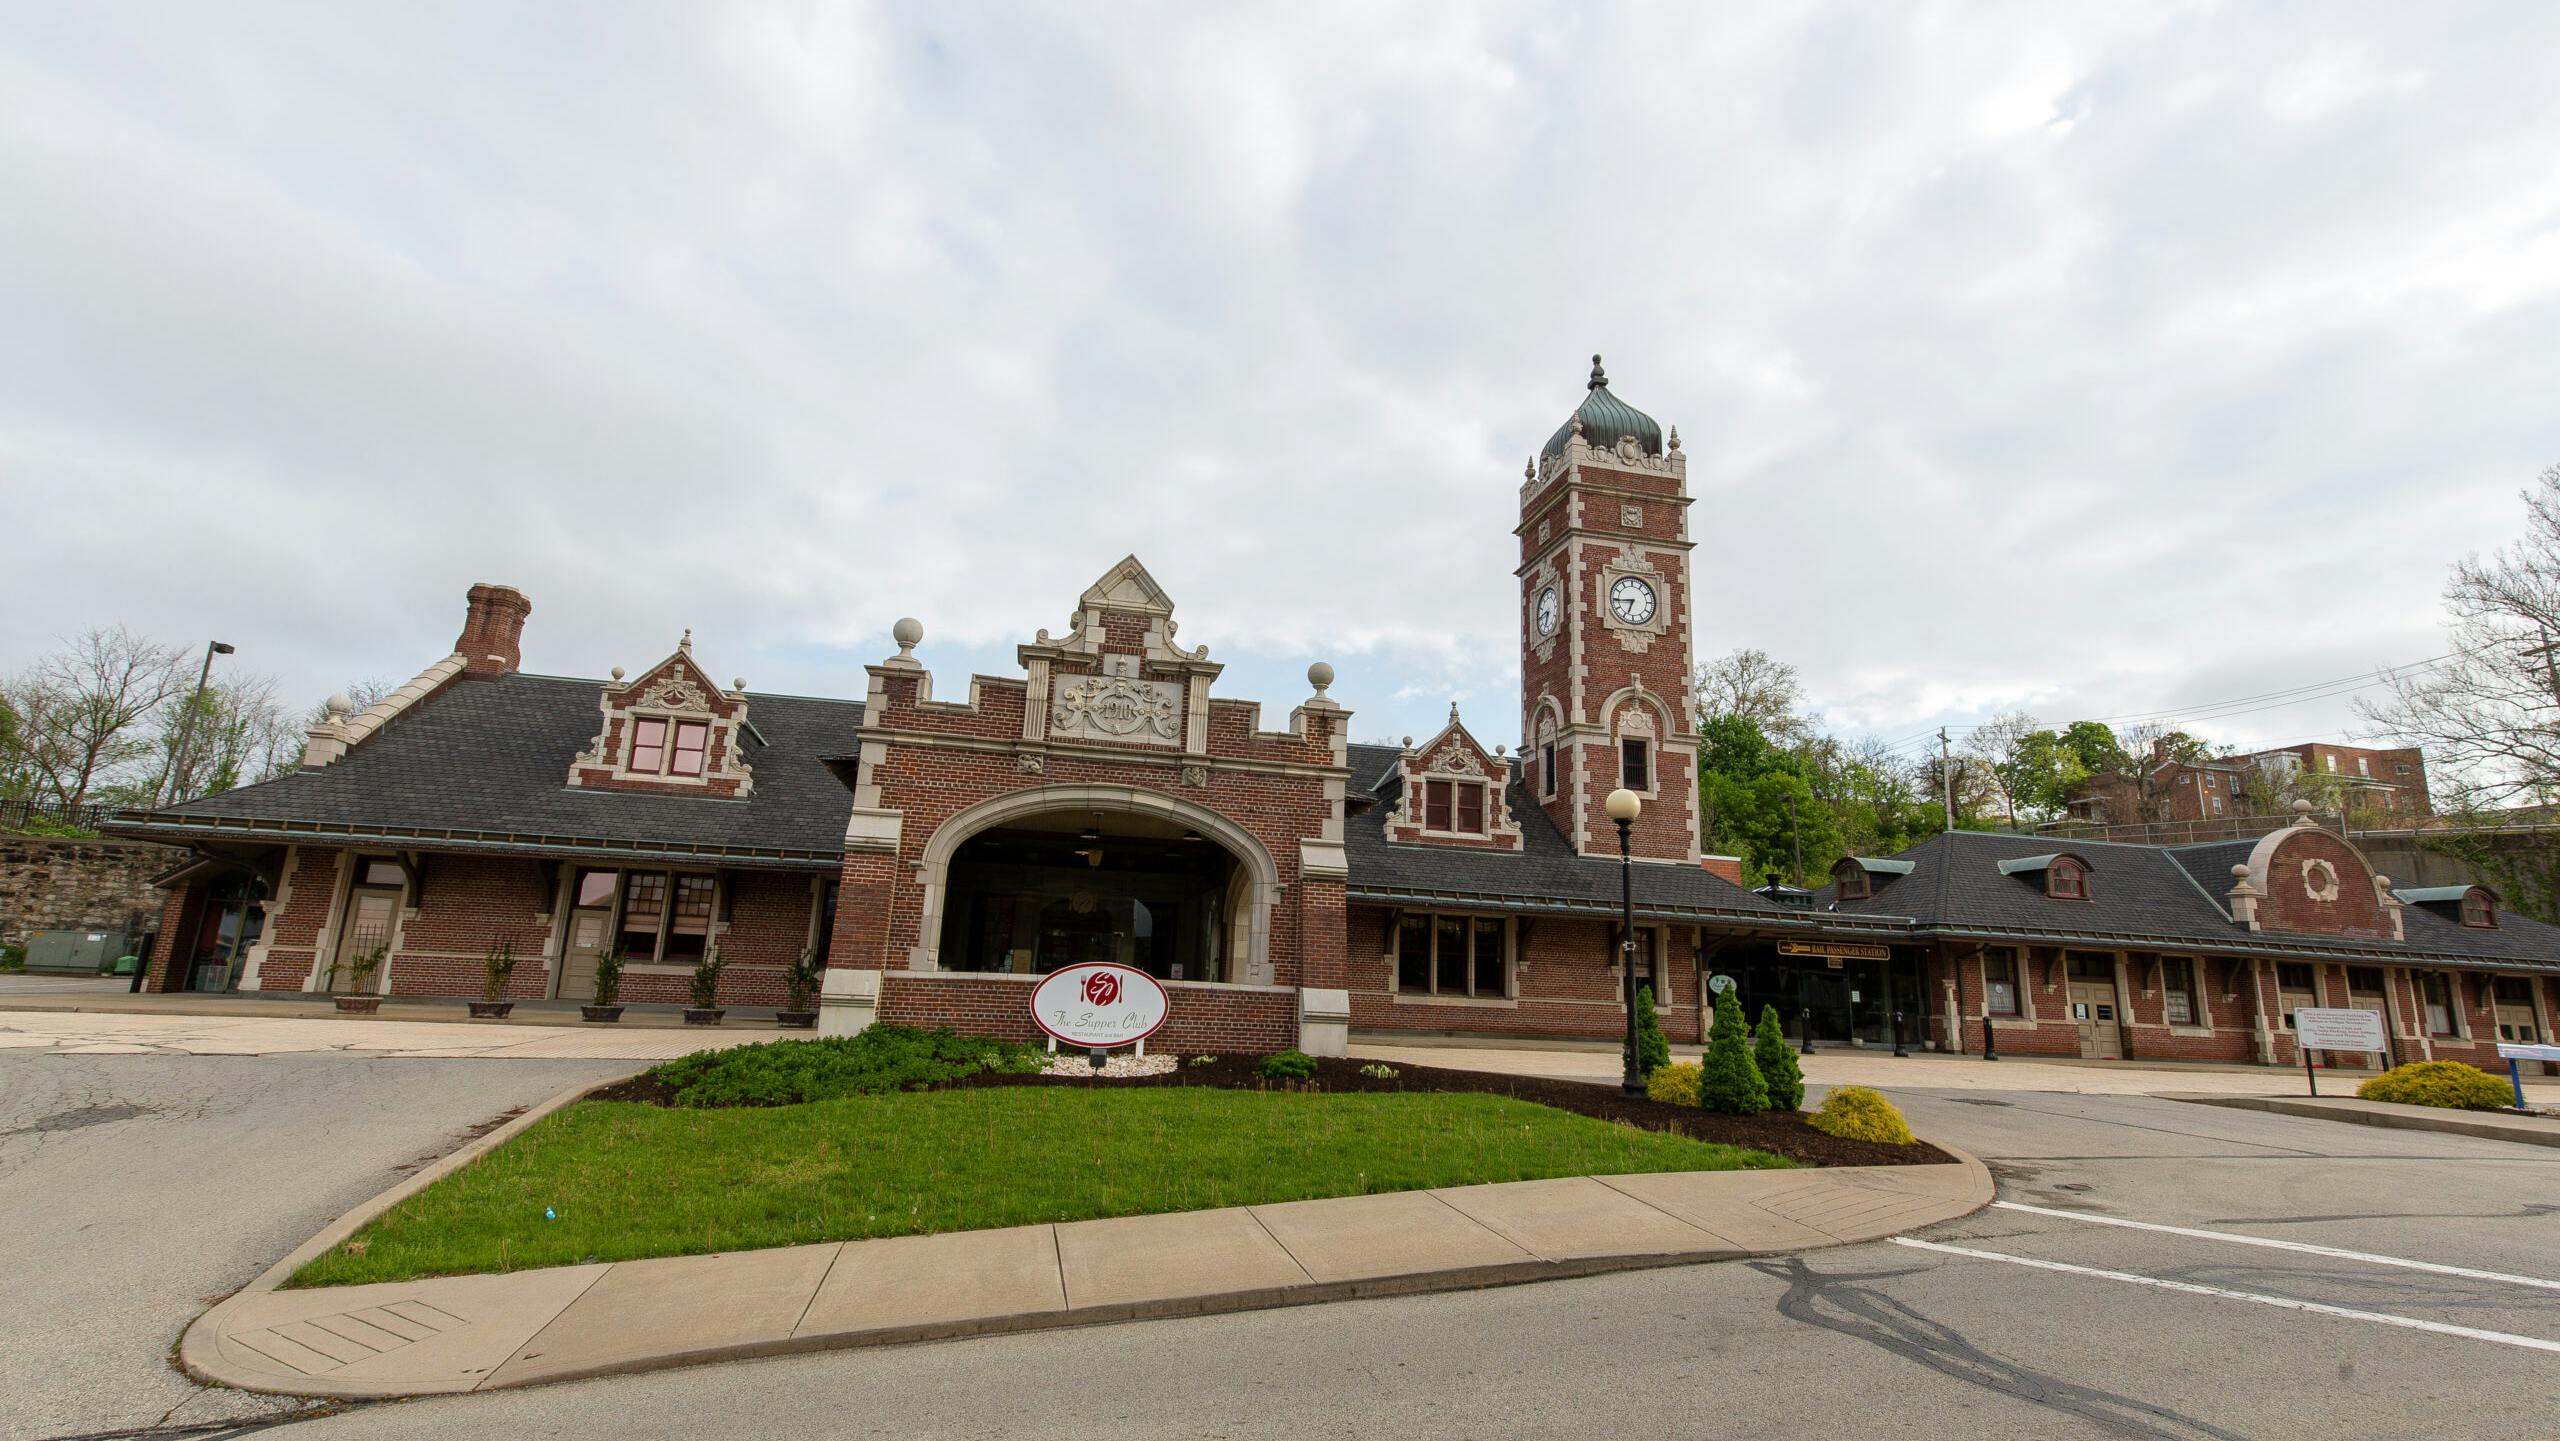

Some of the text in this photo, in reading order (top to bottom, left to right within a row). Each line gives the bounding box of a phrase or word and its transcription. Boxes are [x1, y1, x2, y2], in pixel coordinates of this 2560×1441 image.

[1811, 944, 1887, 958] RAIL PASSENGER STATION
[1051, 1010, 1148, 1031] The Supper Club
